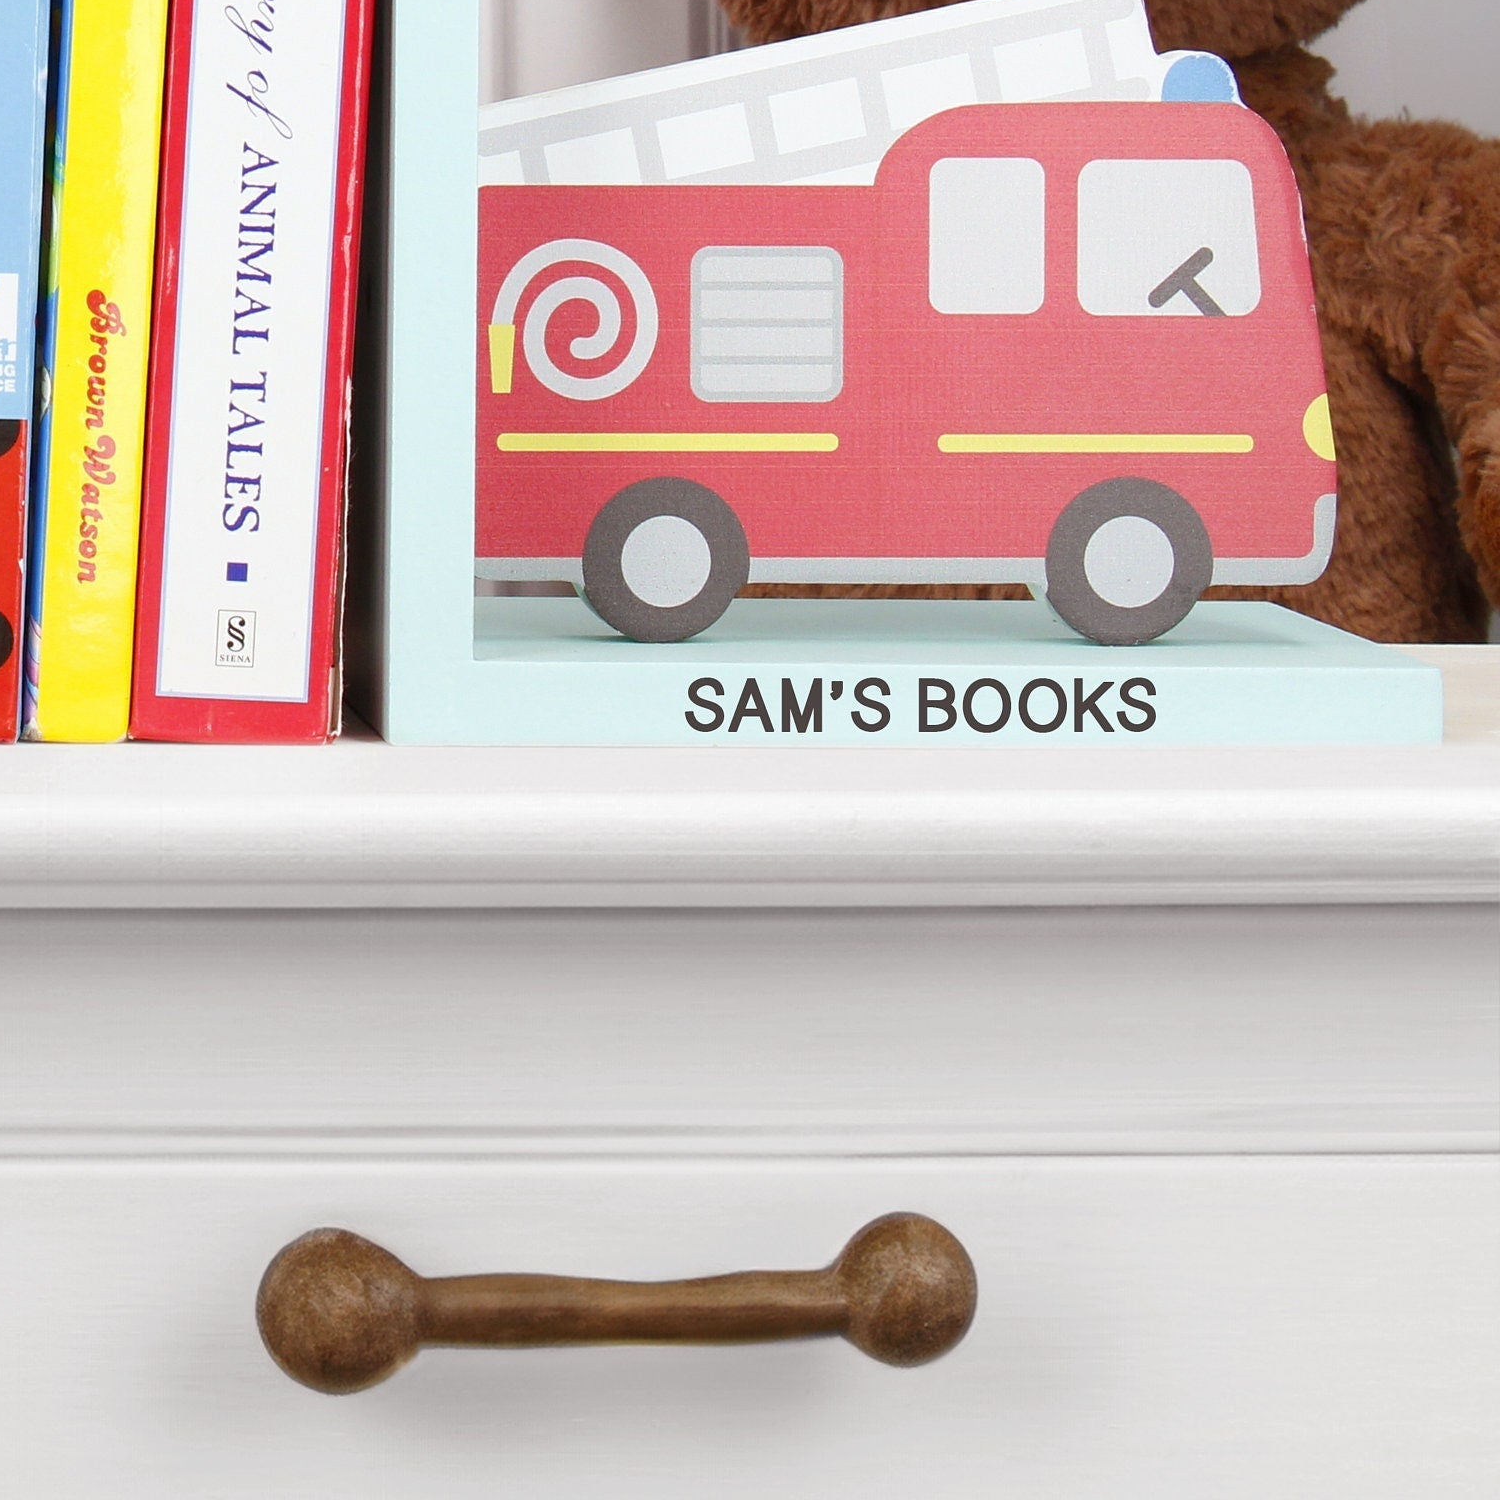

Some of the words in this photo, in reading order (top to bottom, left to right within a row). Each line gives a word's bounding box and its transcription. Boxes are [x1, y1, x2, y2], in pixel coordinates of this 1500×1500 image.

[226, 67, 294, 141] of
[231, 140, 281, 356] ANIMAL
[85, 288, 128, 431] Brown
[75, 433, 118, 585] Watson
[222, 370, 268, 534] TALES
[218, 653, 252, 664] SIENA
[684, 676, 892, 733] SAM'S
[918, 676, 1158, 733] BOOKS
